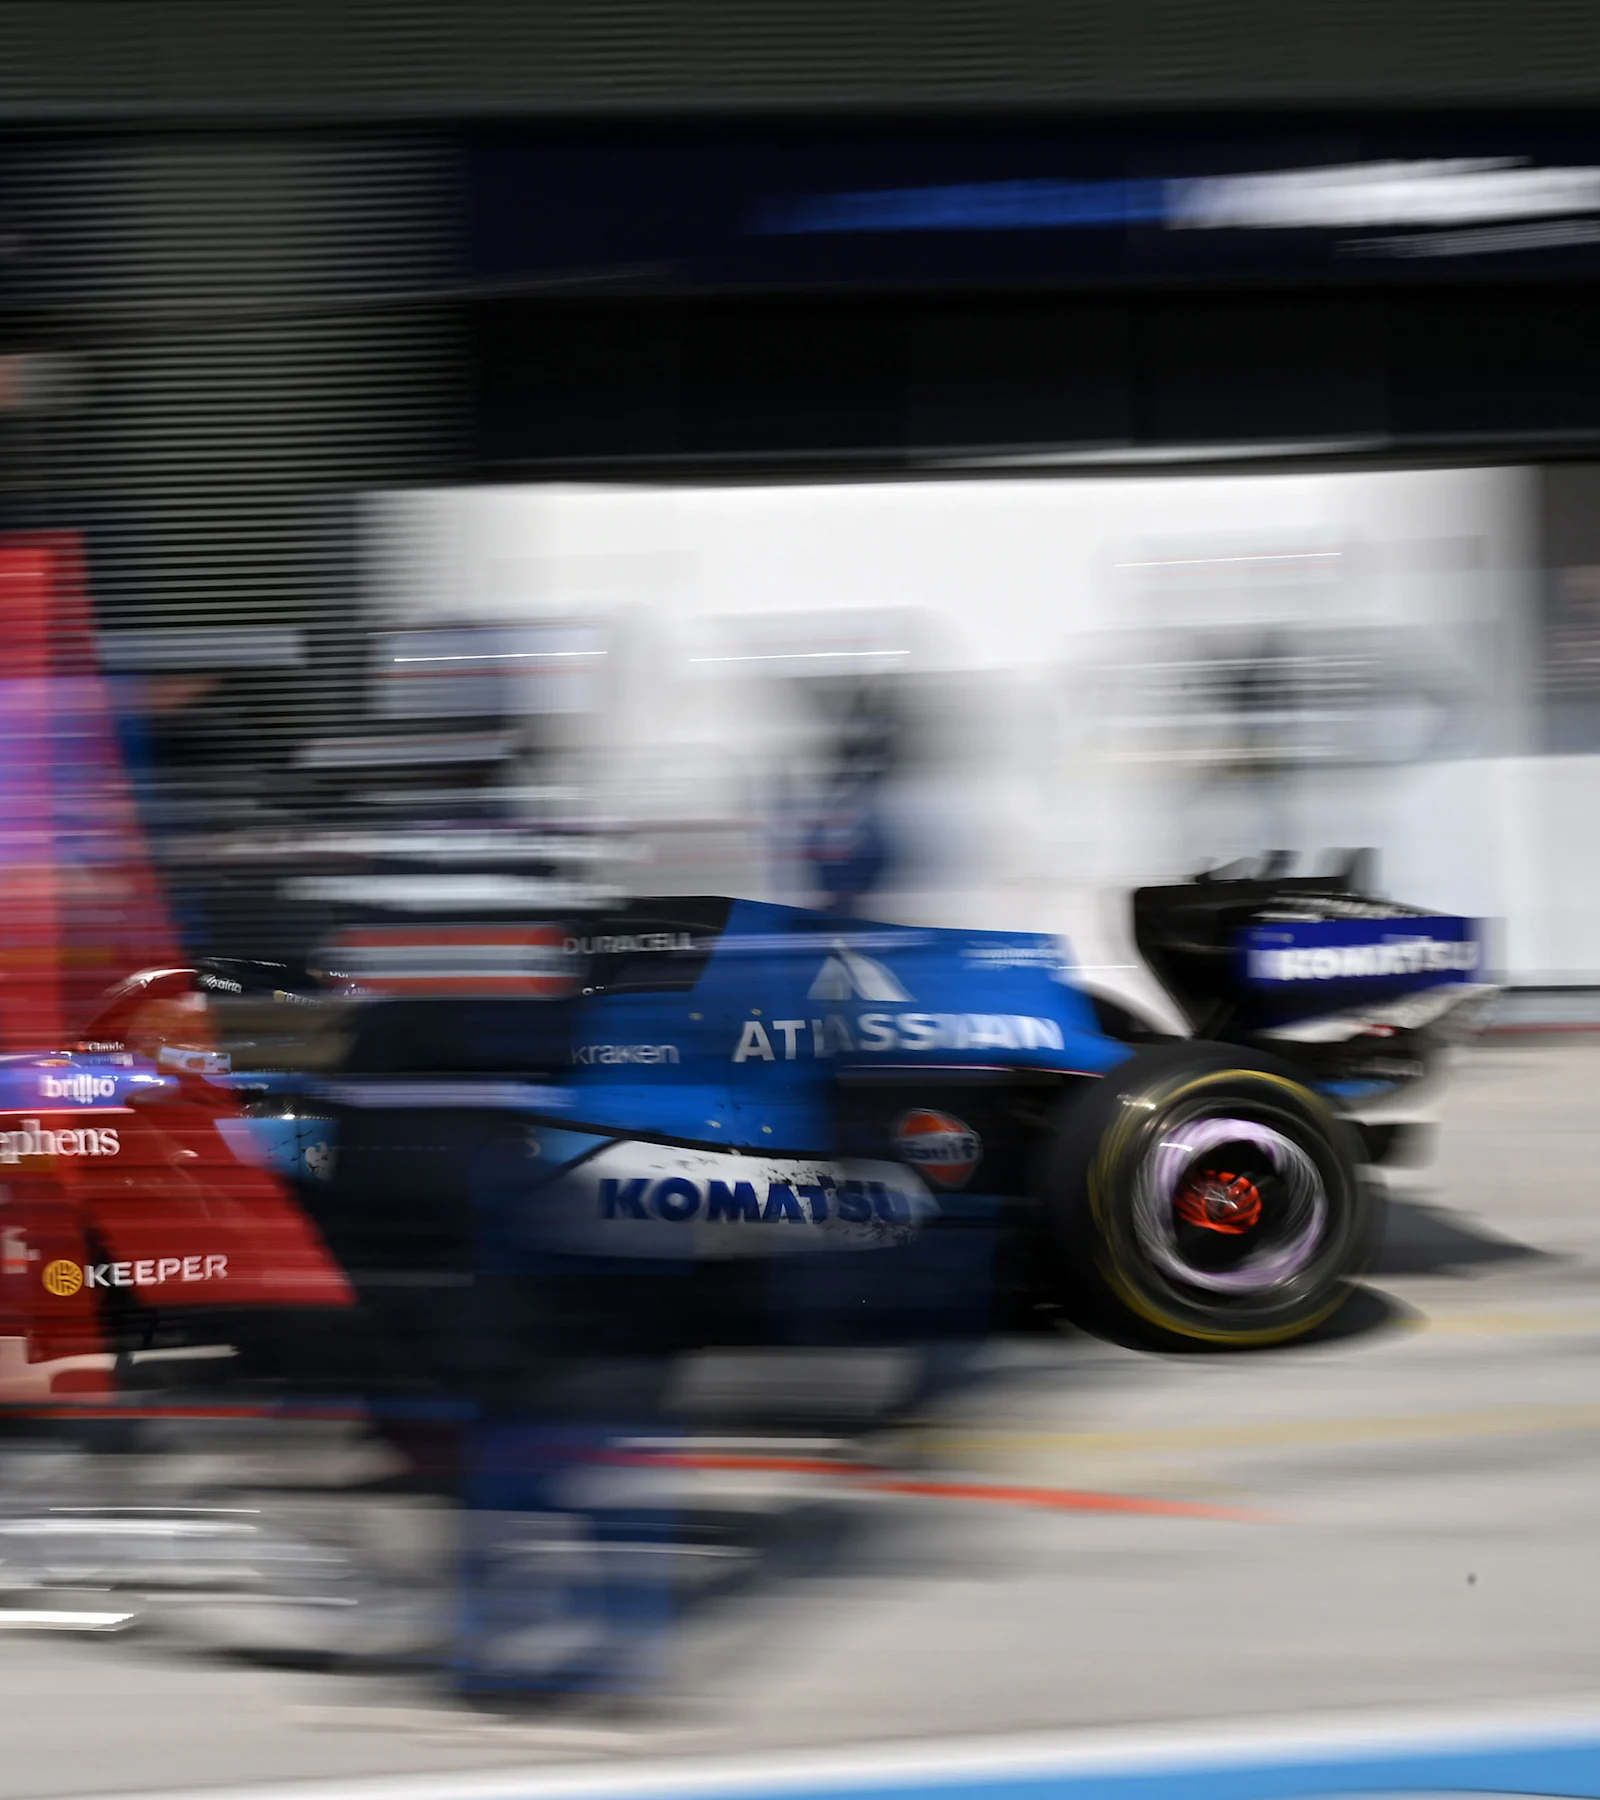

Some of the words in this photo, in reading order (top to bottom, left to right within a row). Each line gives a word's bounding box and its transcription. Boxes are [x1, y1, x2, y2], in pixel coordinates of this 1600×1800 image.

[563, 932, 695, 955] DURACELL
[88, 1041, 125, 1051] Claude
[732, 1013, 1065, 1063] ATLASSIAN
[571, 1044, 680, 1064] kraken
[600, 1176, 912, 1226] KOMATSU
[83, 1254, 229, 1288] KEEPER
